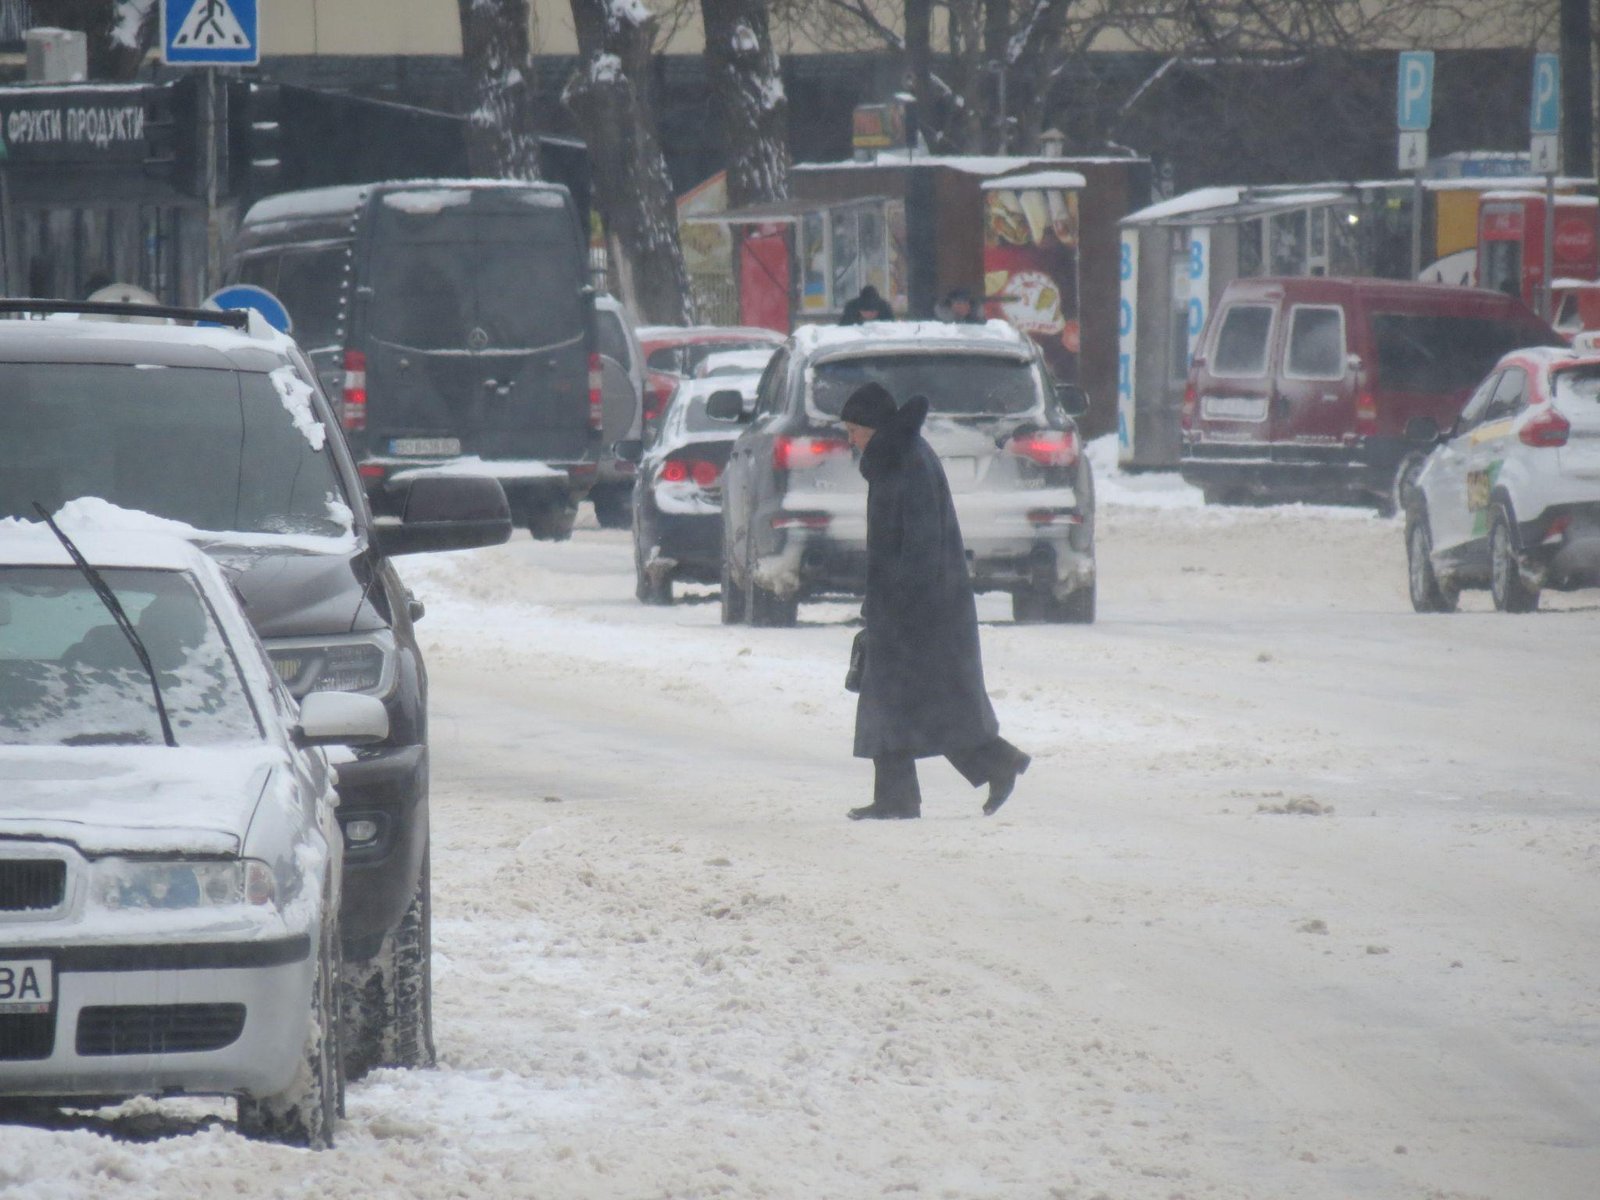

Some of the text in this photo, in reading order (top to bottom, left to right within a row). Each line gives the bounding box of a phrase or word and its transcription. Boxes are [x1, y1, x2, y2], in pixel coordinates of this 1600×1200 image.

[1404, 60, 1425, 121] P
[1535, 63, 1553, 124] P
[8, 107, 144, 148] ФРУКТИ ПРОДУКТИ
